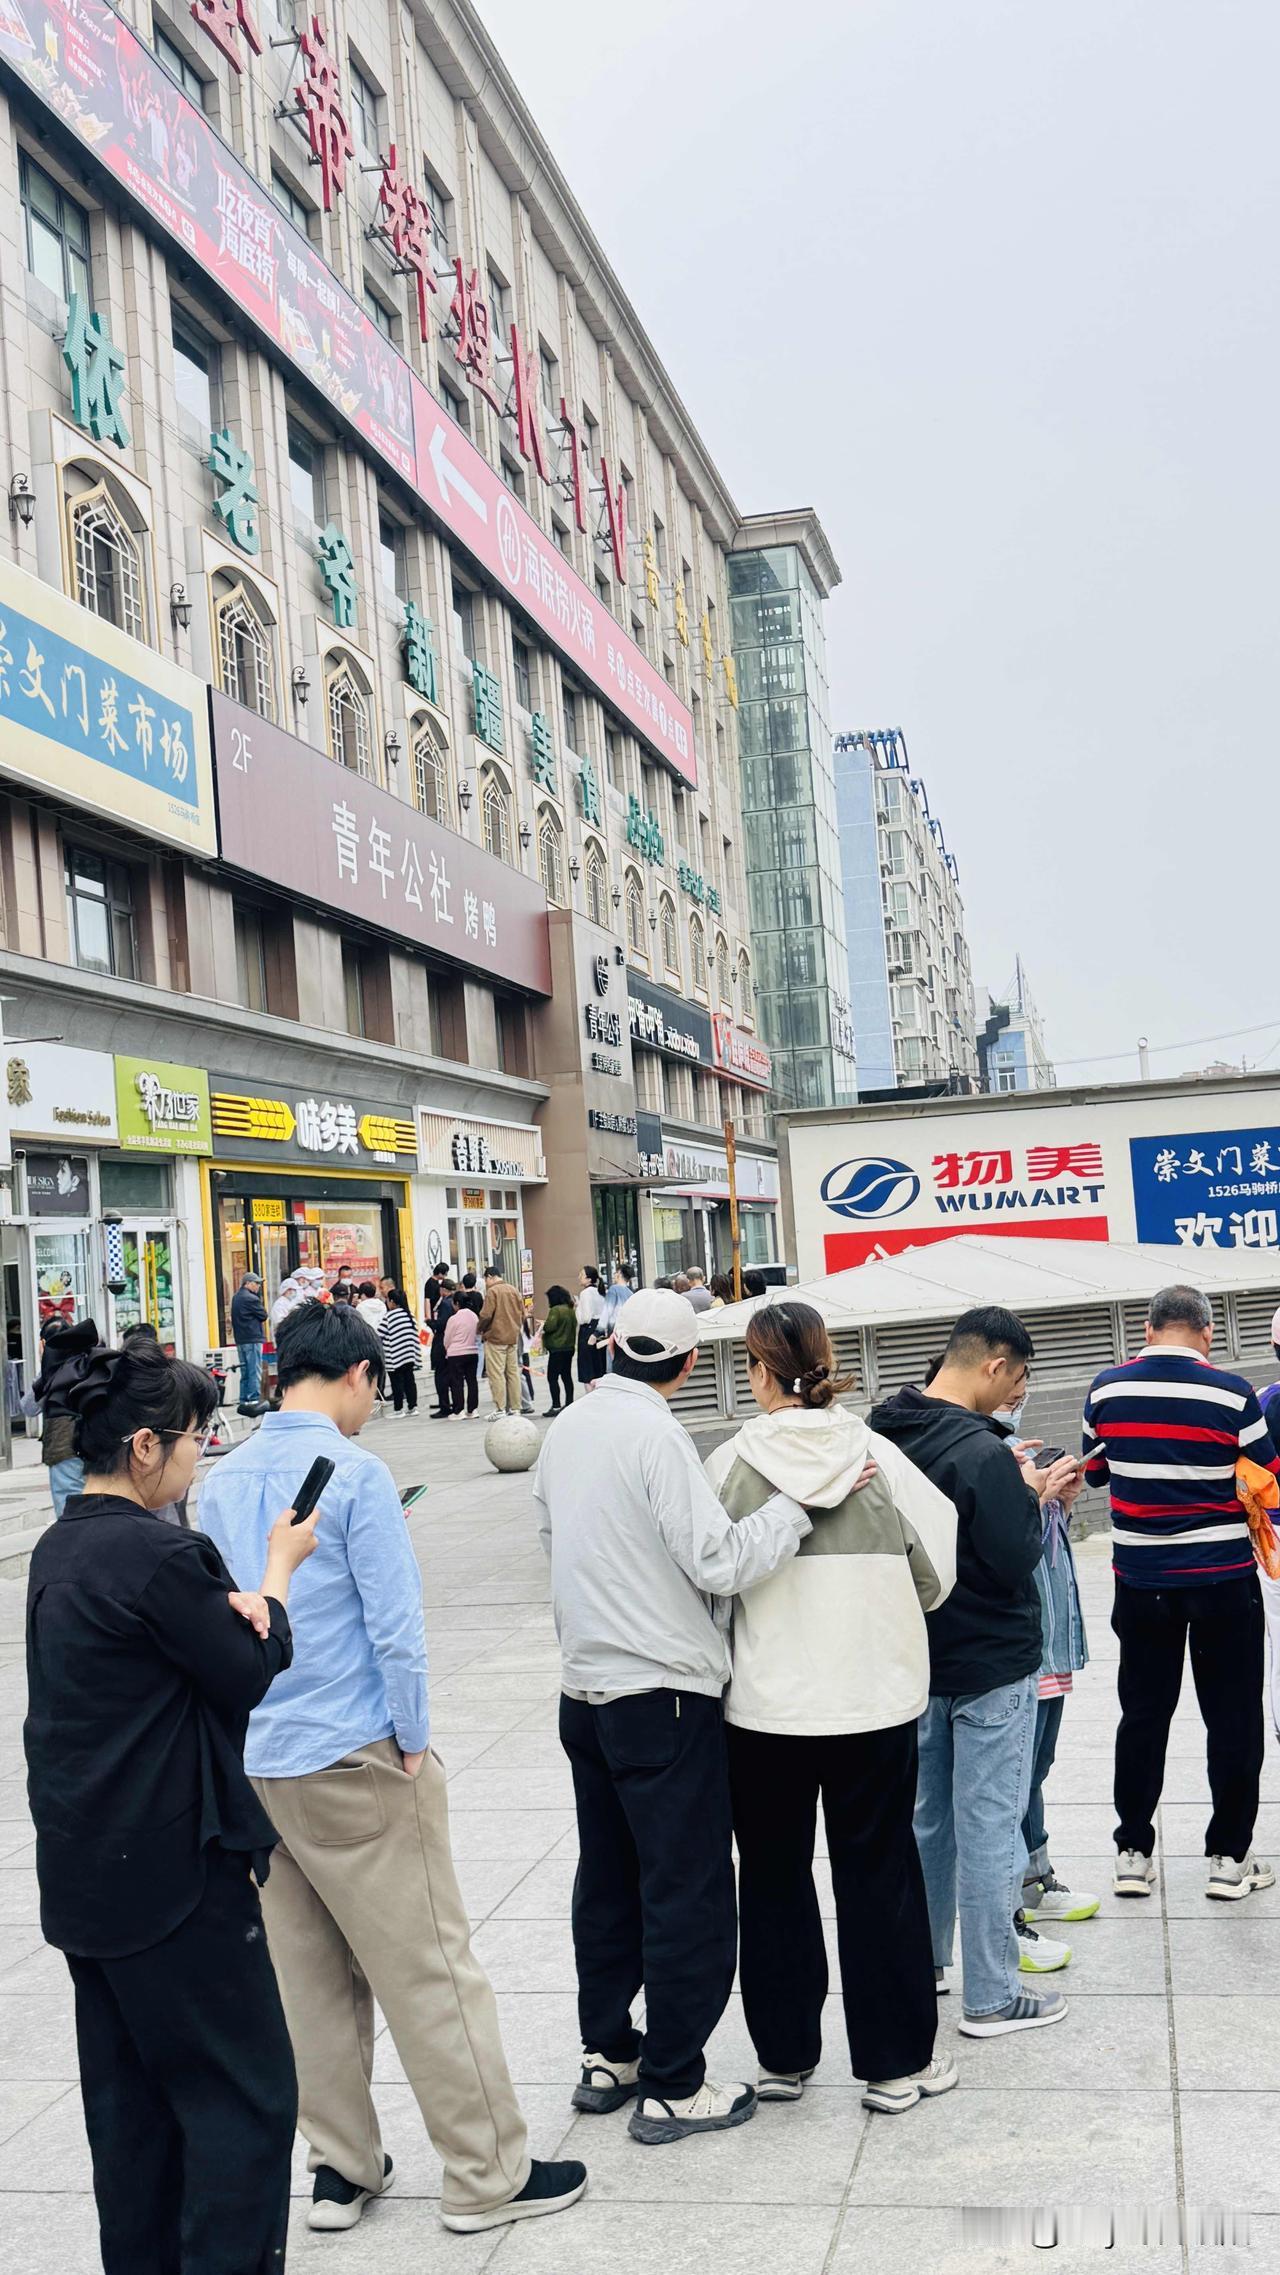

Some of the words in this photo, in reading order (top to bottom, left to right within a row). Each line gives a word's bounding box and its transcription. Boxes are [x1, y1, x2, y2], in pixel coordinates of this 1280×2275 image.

[522, 532, 597, 660] 海底捞火锅
[231, 727, 252, 773] 2F
[331, 800, 454, 924] 青年公社
[463, 888, 497, 947] 烤鸭
[585, 1003, 624, 1047] 青年公社
[295, 1099, 359, 1155] 味多美
[931, 1142, 1104, 1189] 物美
[1154, 1140, 1280, 1182] 崇文门菜
[934, 1184, 1105, 1214] WUMART
[1208, 1180, 1280, 1198] 1526马驹桥
[1174, 1208, 1279, 1249] 欢迎
